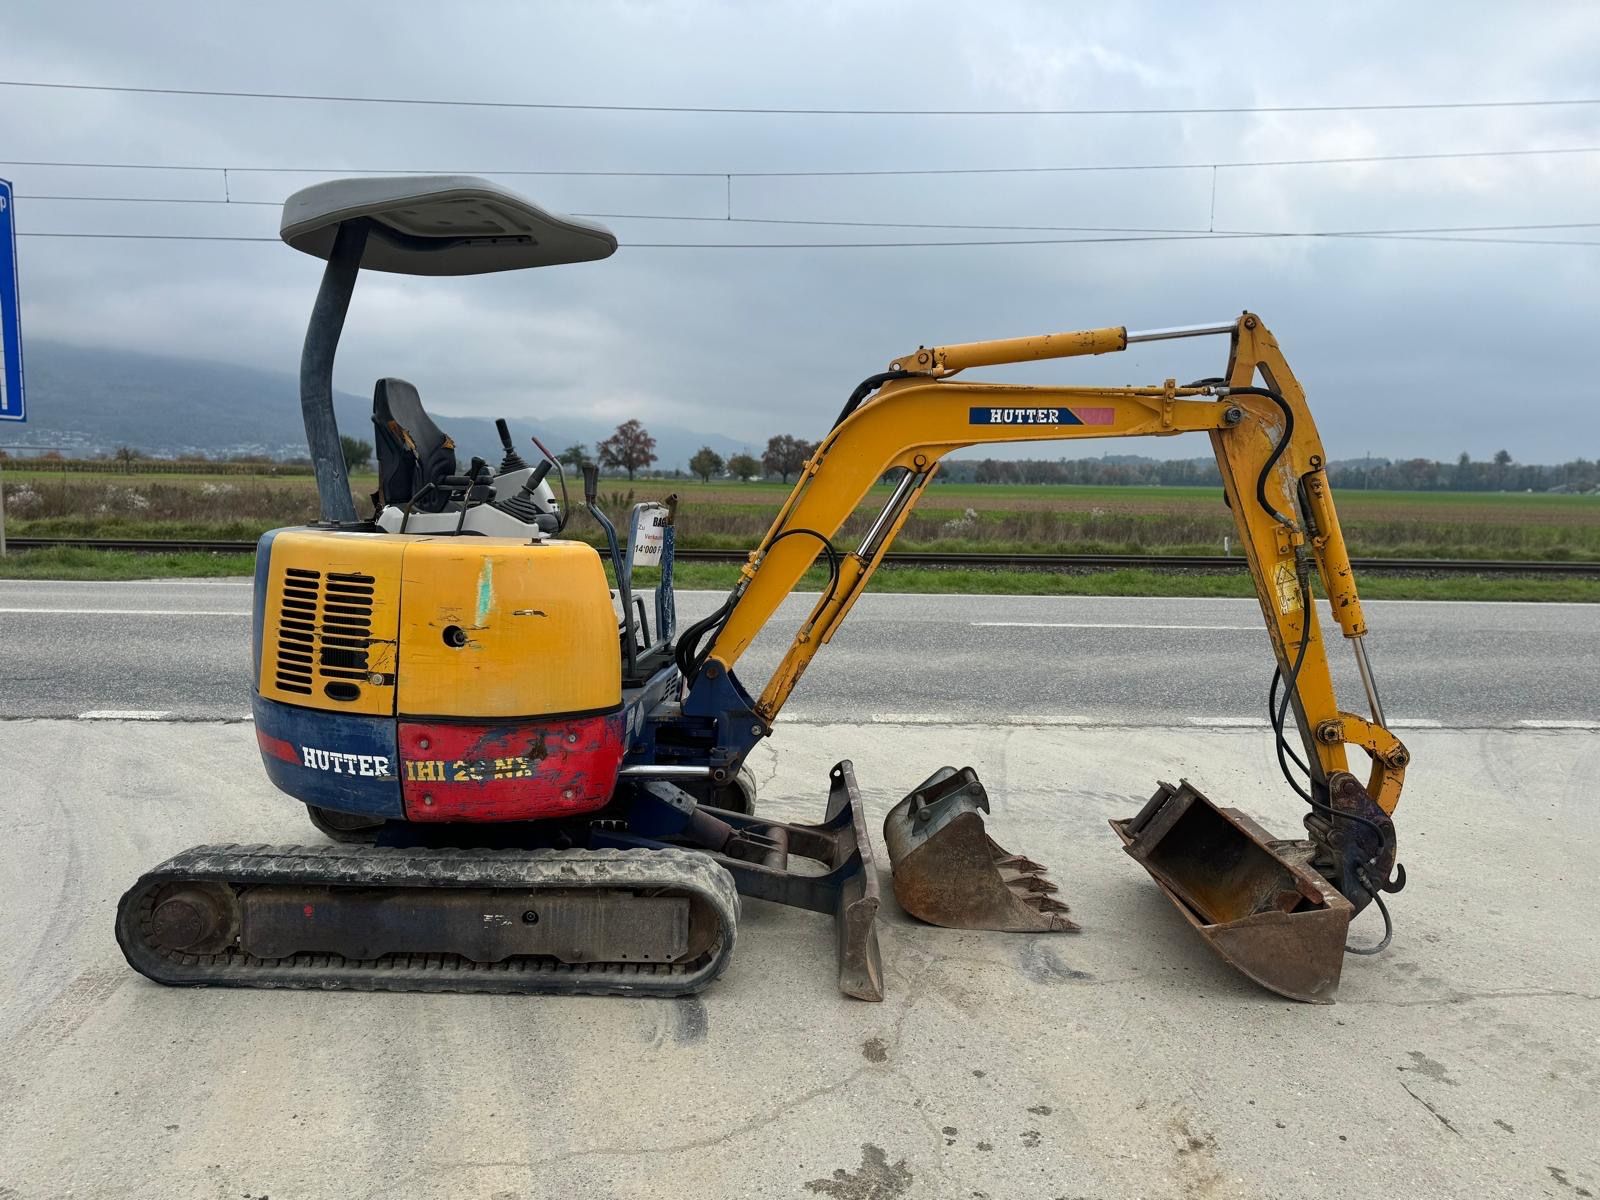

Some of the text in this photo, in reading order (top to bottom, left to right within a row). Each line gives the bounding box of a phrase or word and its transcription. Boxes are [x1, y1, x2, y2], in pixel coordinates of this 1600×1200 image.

[990, 409, 1059, 424] HUTTER
[635, 544, 657, 554] 14'000
[302, 746, 391, 777] HUTTER
[405, 760, 446, 782] IHI
